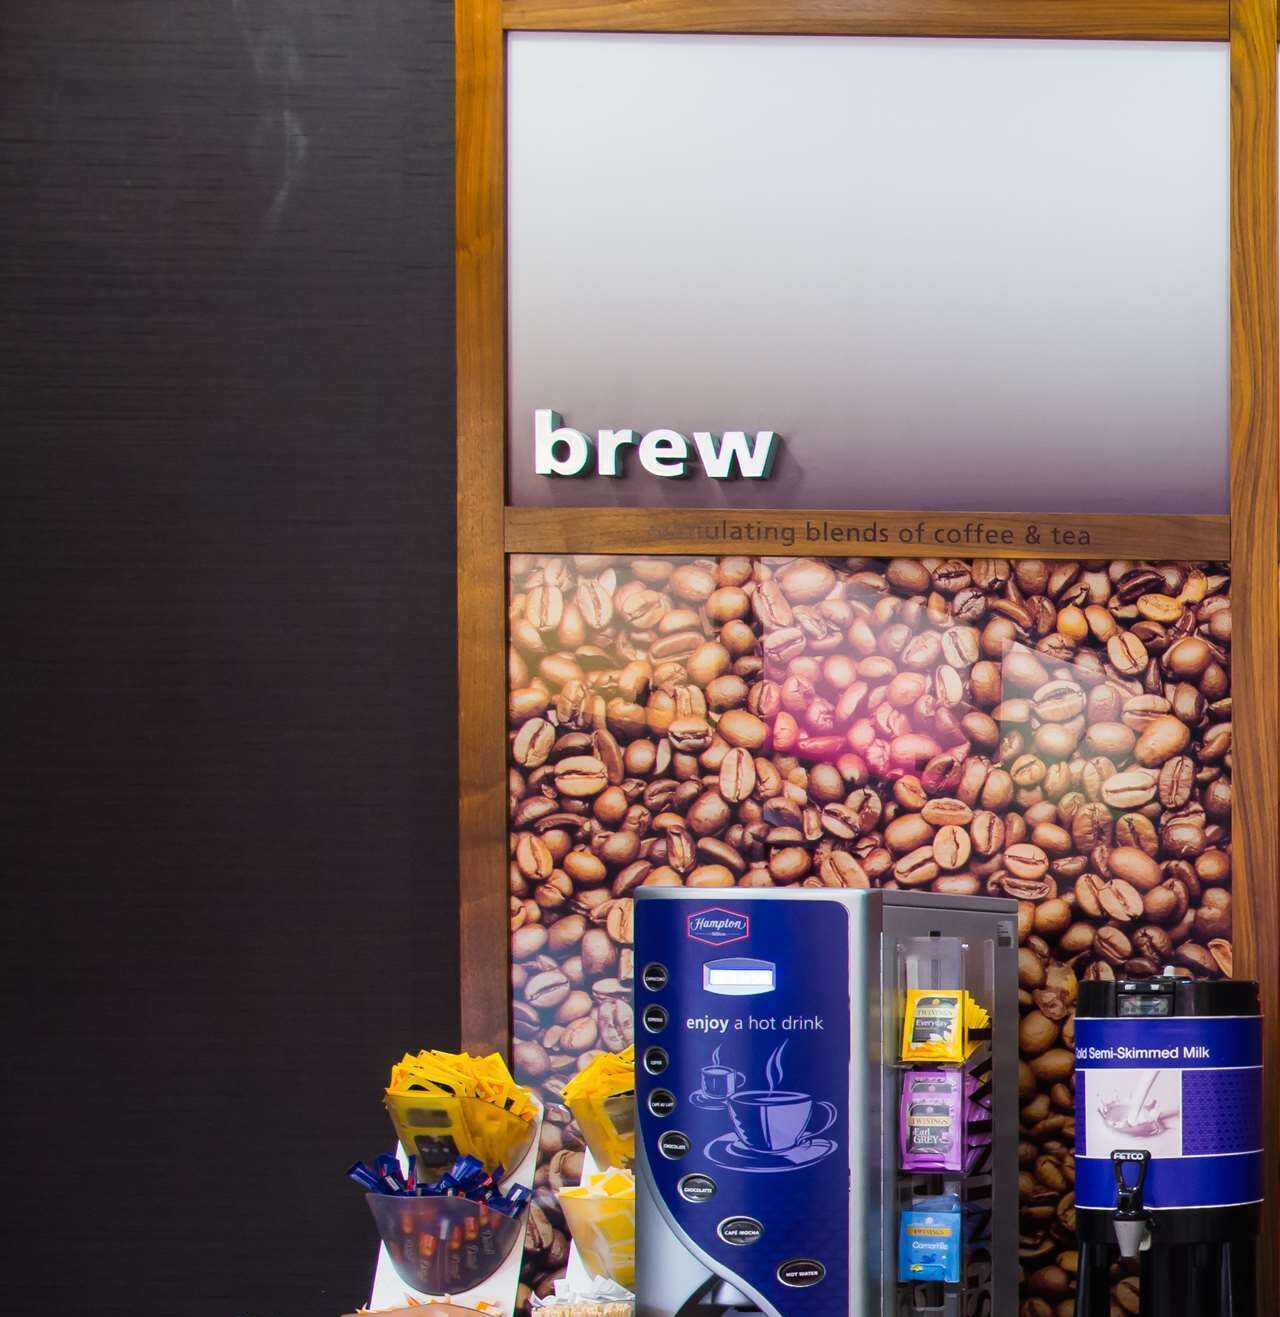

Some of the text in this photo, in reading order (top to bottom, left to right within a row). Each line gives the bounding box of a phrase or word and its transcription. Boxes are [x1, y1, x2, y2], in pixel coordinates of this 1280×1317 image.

[534, 408, 779, 479] brew
[805, 520, 890, 543] blends
[897, 520, 928, 544] of
[933, 521, 1020, 546] coffee
[1024, 524, 1042, 546] &
[1049, 524, 1092, 547] tea
[690, 917, 746, 932] Hampton
[686, 1015, 824, 1033] enjoy a hot drink
[1089, 1046, 1179, 1059] Semi-Skimmed
[1183, 1046, 1210, 1058] Milk
[913, 1127, 930, 1136] Earl
[913, 1135, 939, 1144] GREY
[1113, 1152, 1144, 1160] FETCO
